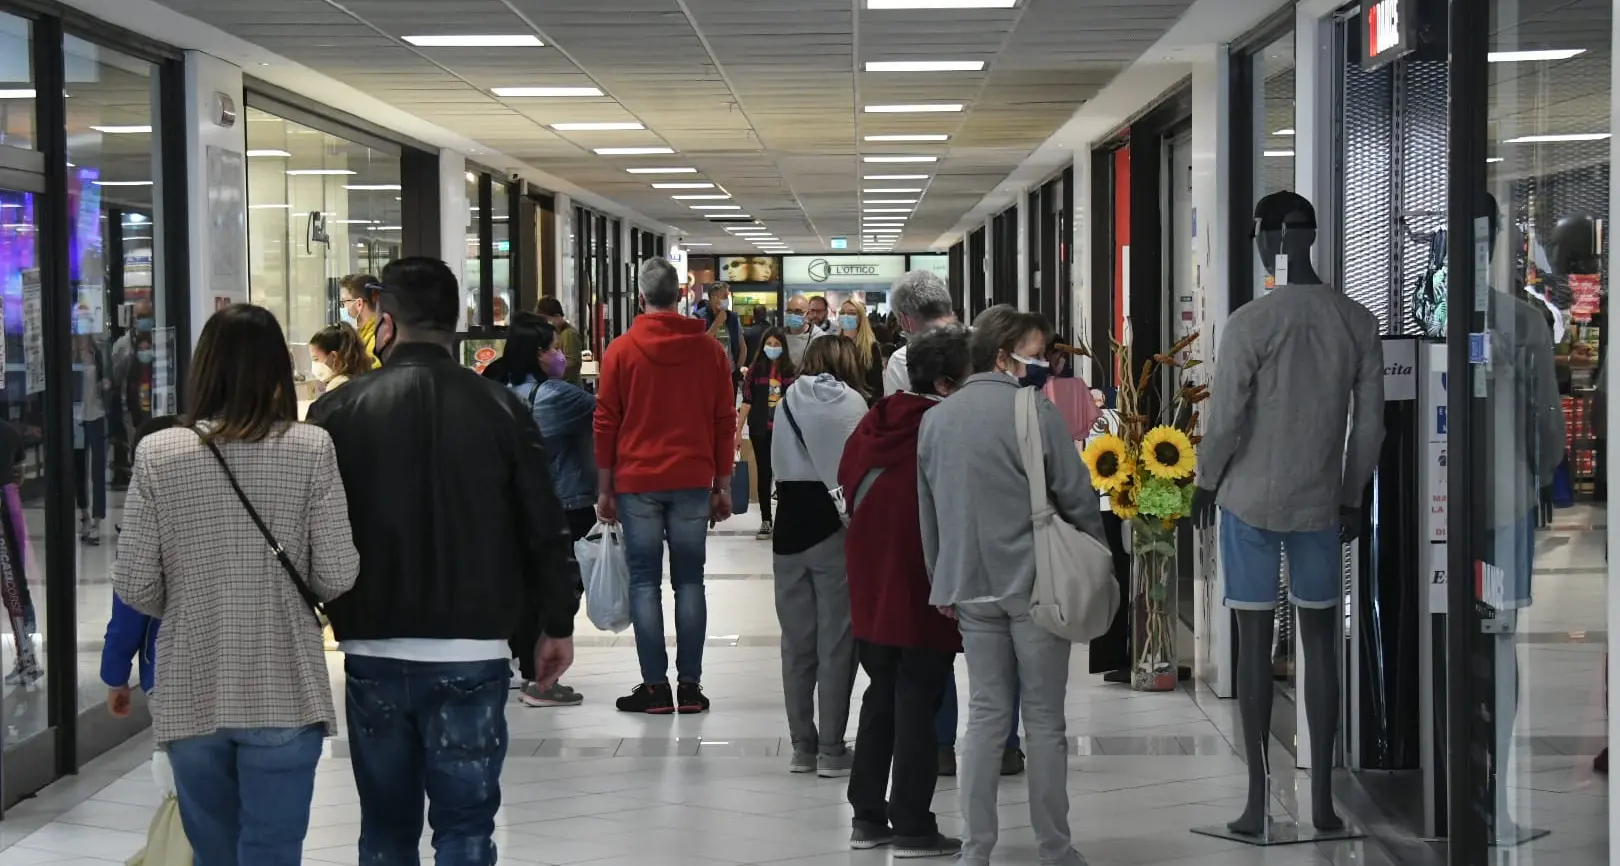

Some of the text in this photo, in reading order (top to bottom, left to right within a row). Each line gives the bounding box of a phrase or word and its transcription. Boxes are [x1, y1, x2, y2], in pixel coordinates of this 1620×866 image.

[836, 266, 875, 274] L'OTTICO
[1383, 362, 1412, 376] cita
[1432, 570, 1447, 584] E
